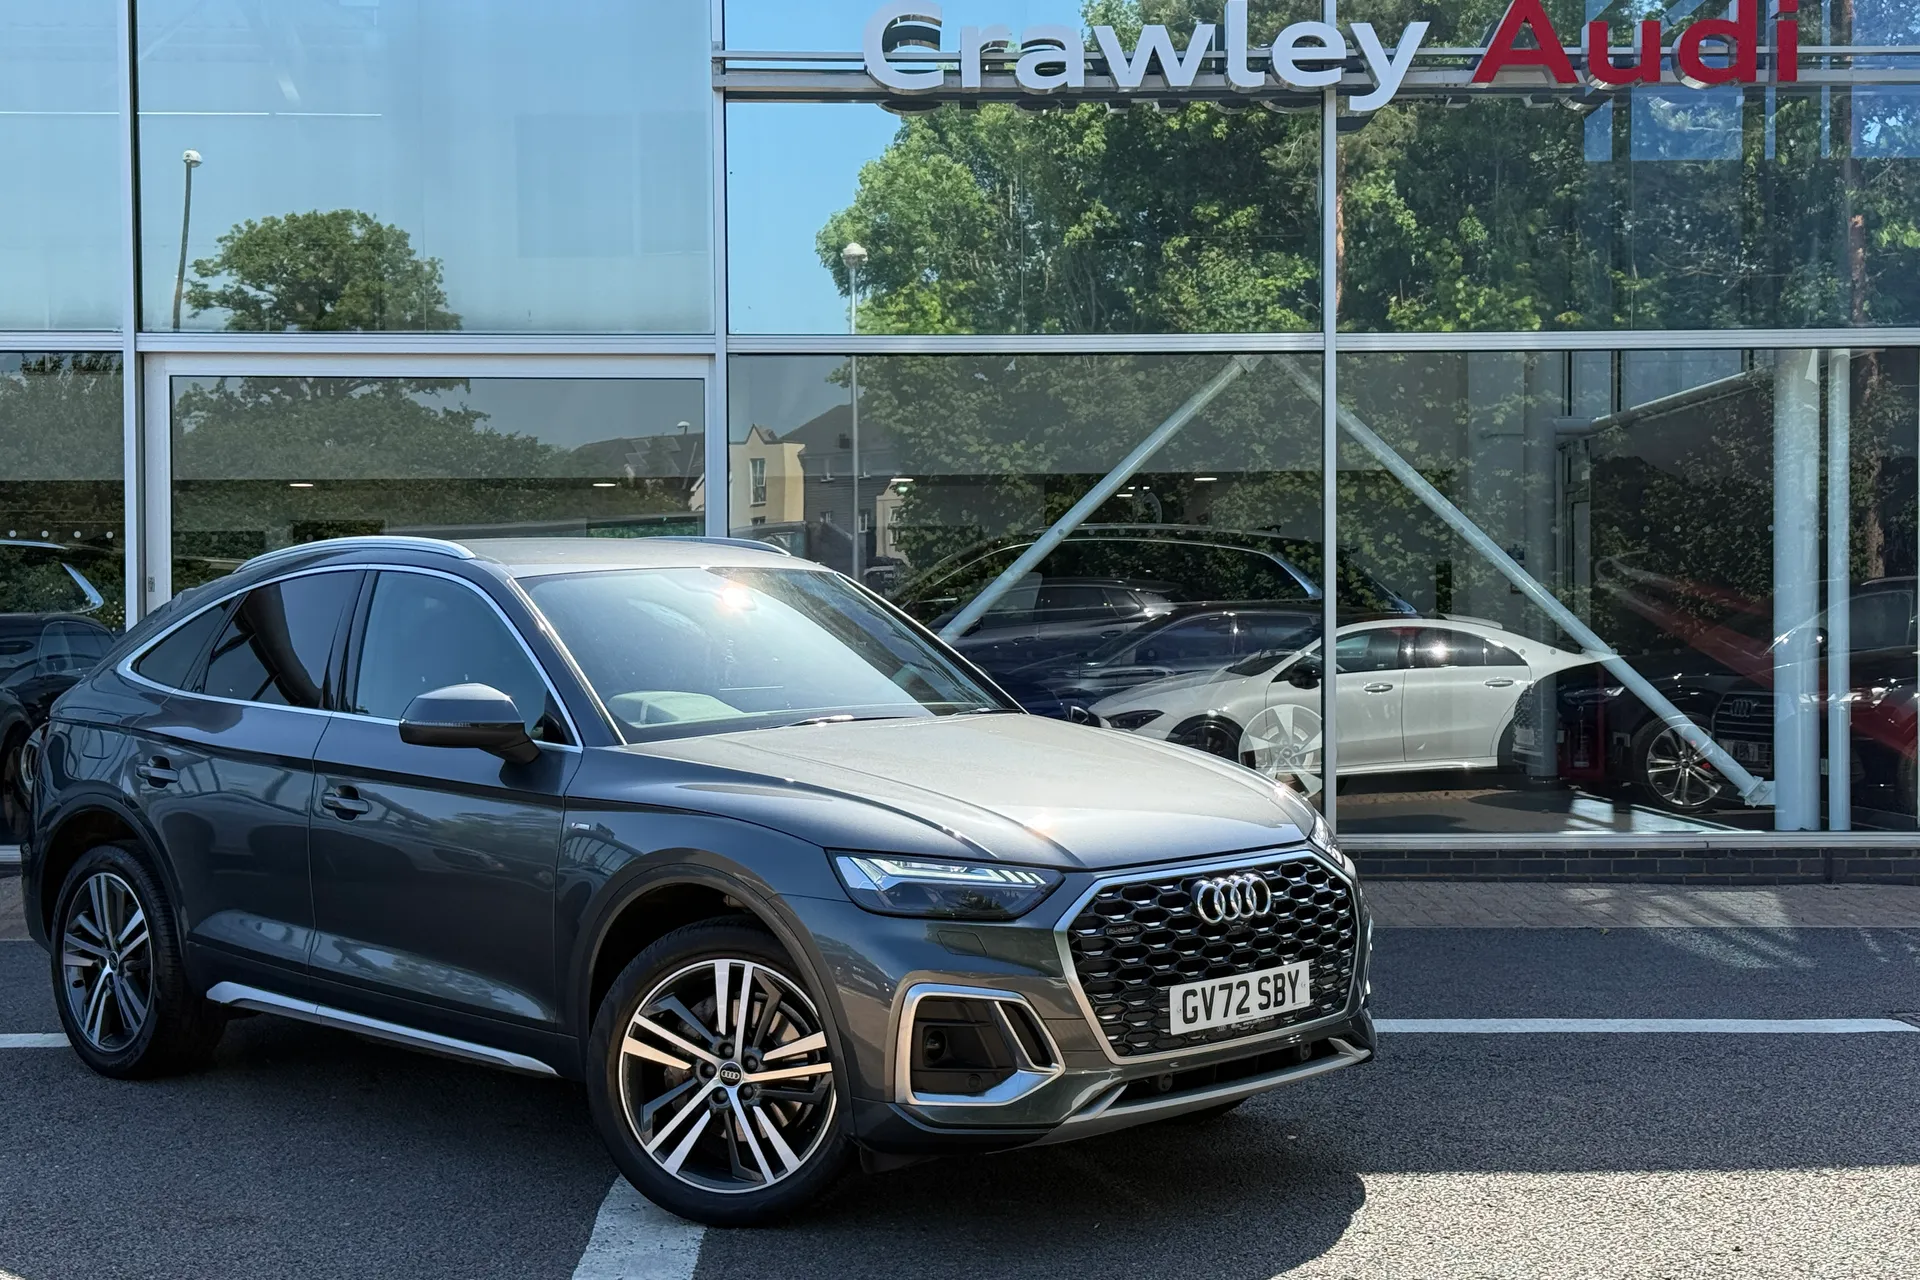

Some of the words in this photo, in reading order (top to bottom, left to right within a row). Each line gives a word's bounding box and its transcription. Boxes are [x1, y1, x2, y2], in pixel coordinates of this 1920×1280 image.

[863, 0, 1430, 112] Crawley
[1469, 0, 1798, 85] Audi
[1182, 980, 1250, 1025] GV72
[1257, 969, 1300, 1011] SBY
